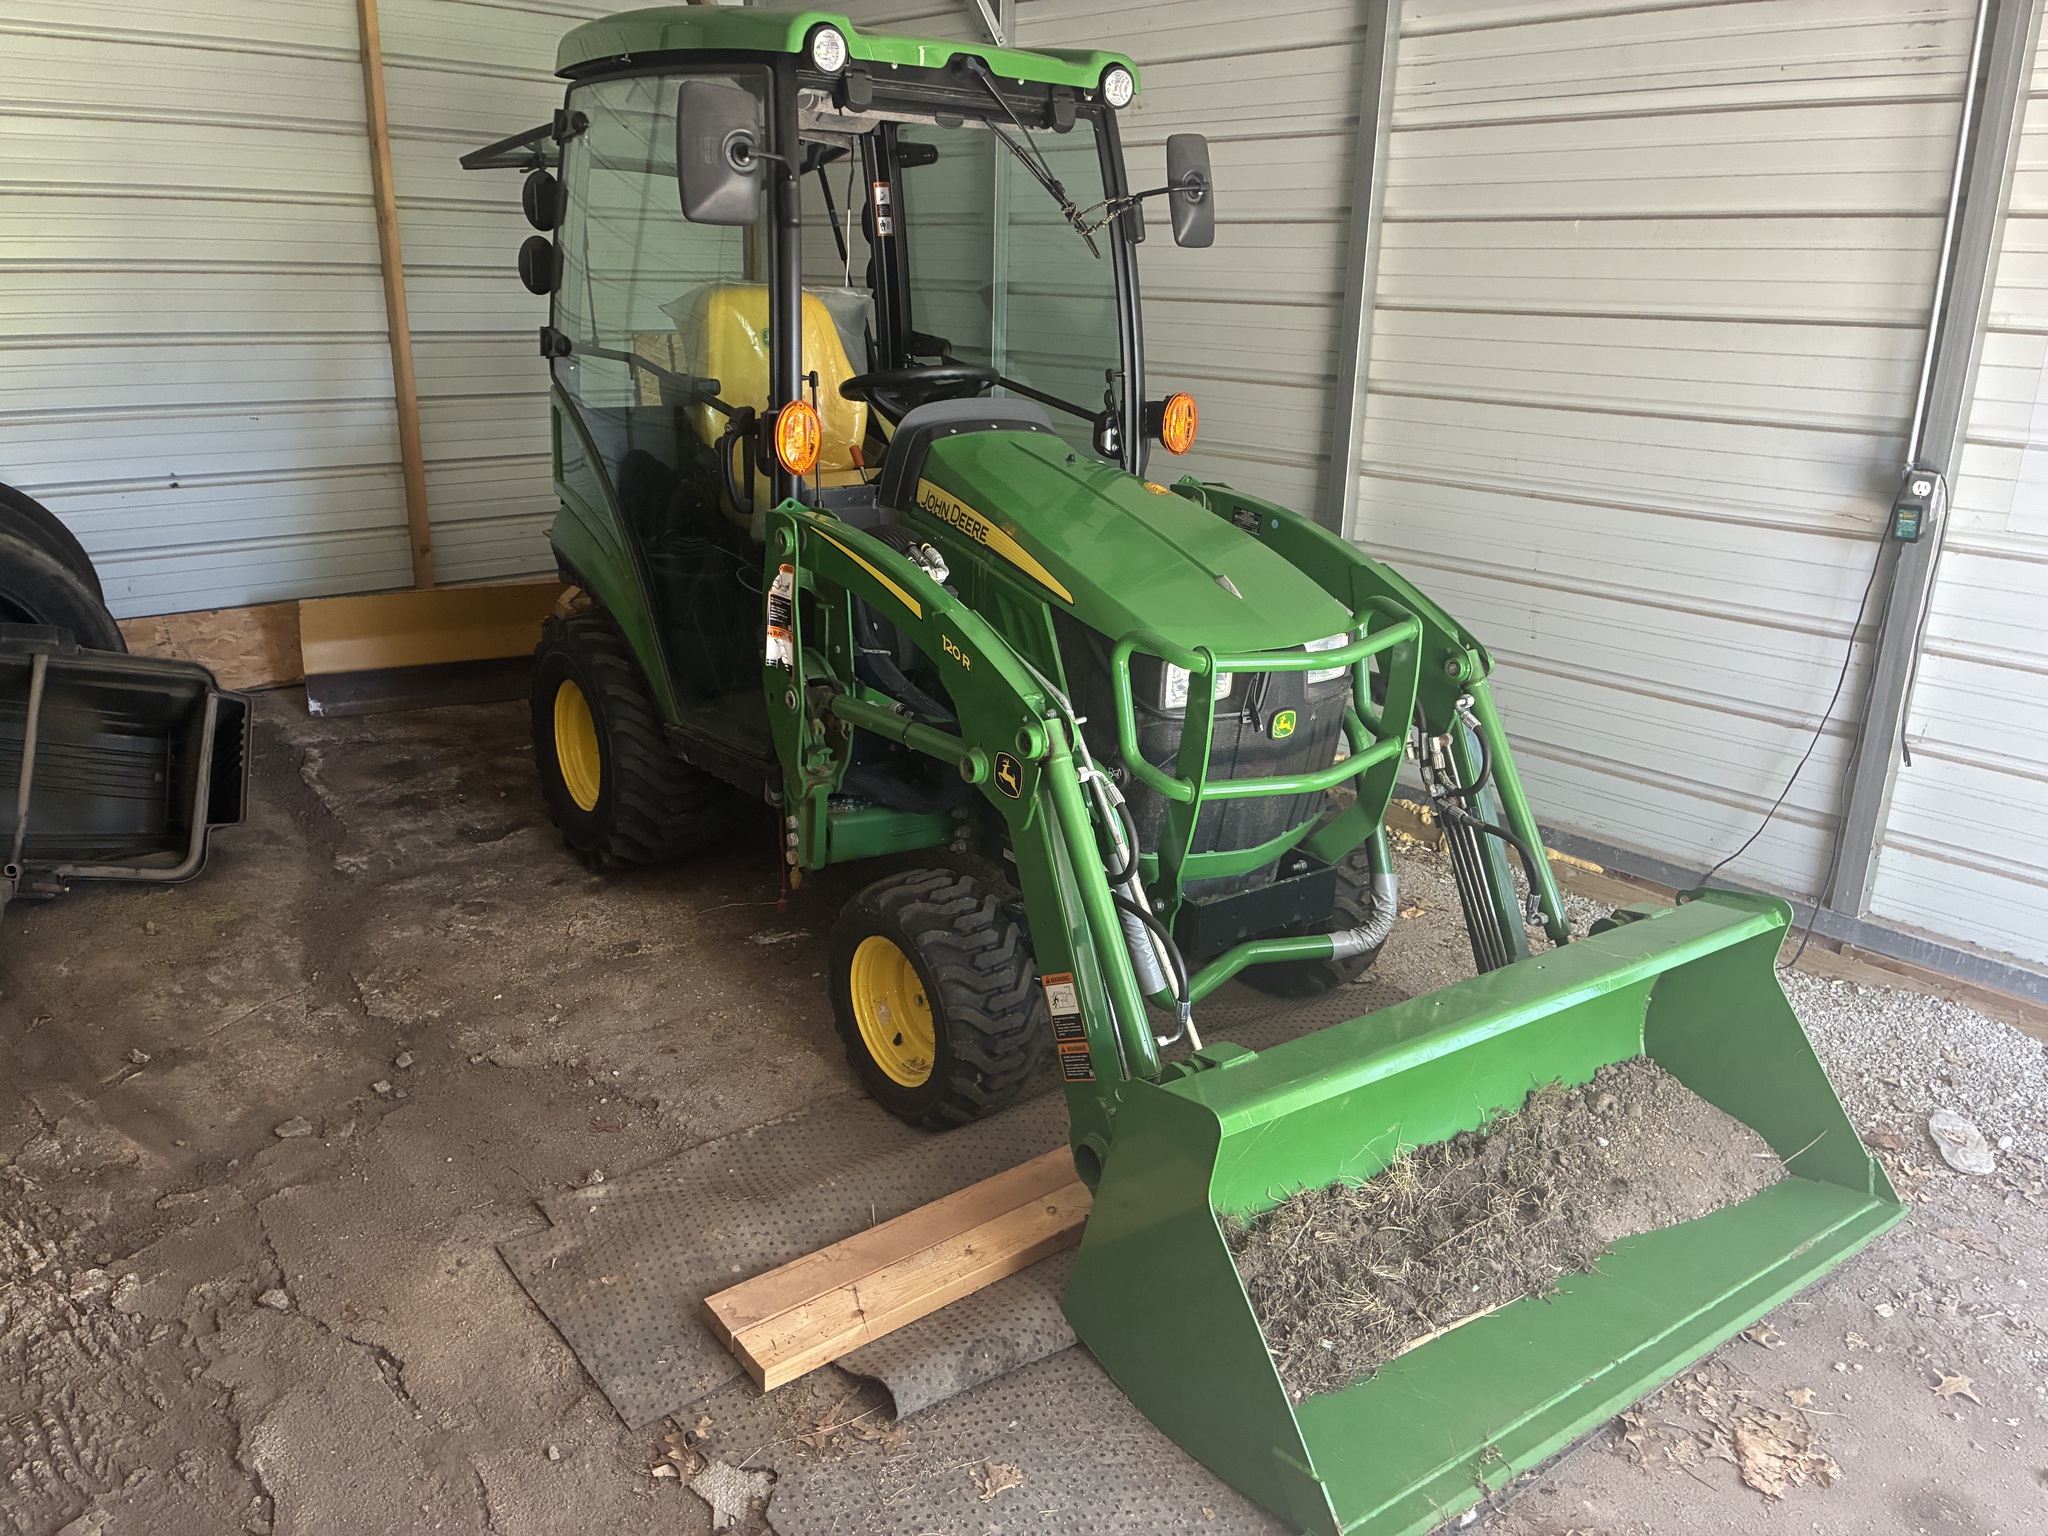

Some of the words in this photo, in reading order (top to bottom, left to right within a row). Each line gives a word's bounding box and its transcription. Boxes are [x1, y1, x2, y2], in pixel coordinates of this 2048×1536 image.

[921, 489, 950, 519] JOHN
[950, 503, 990, 543] DEERE
[941, 633, 961, 661] 120
[962, 653, 971, 672] R
